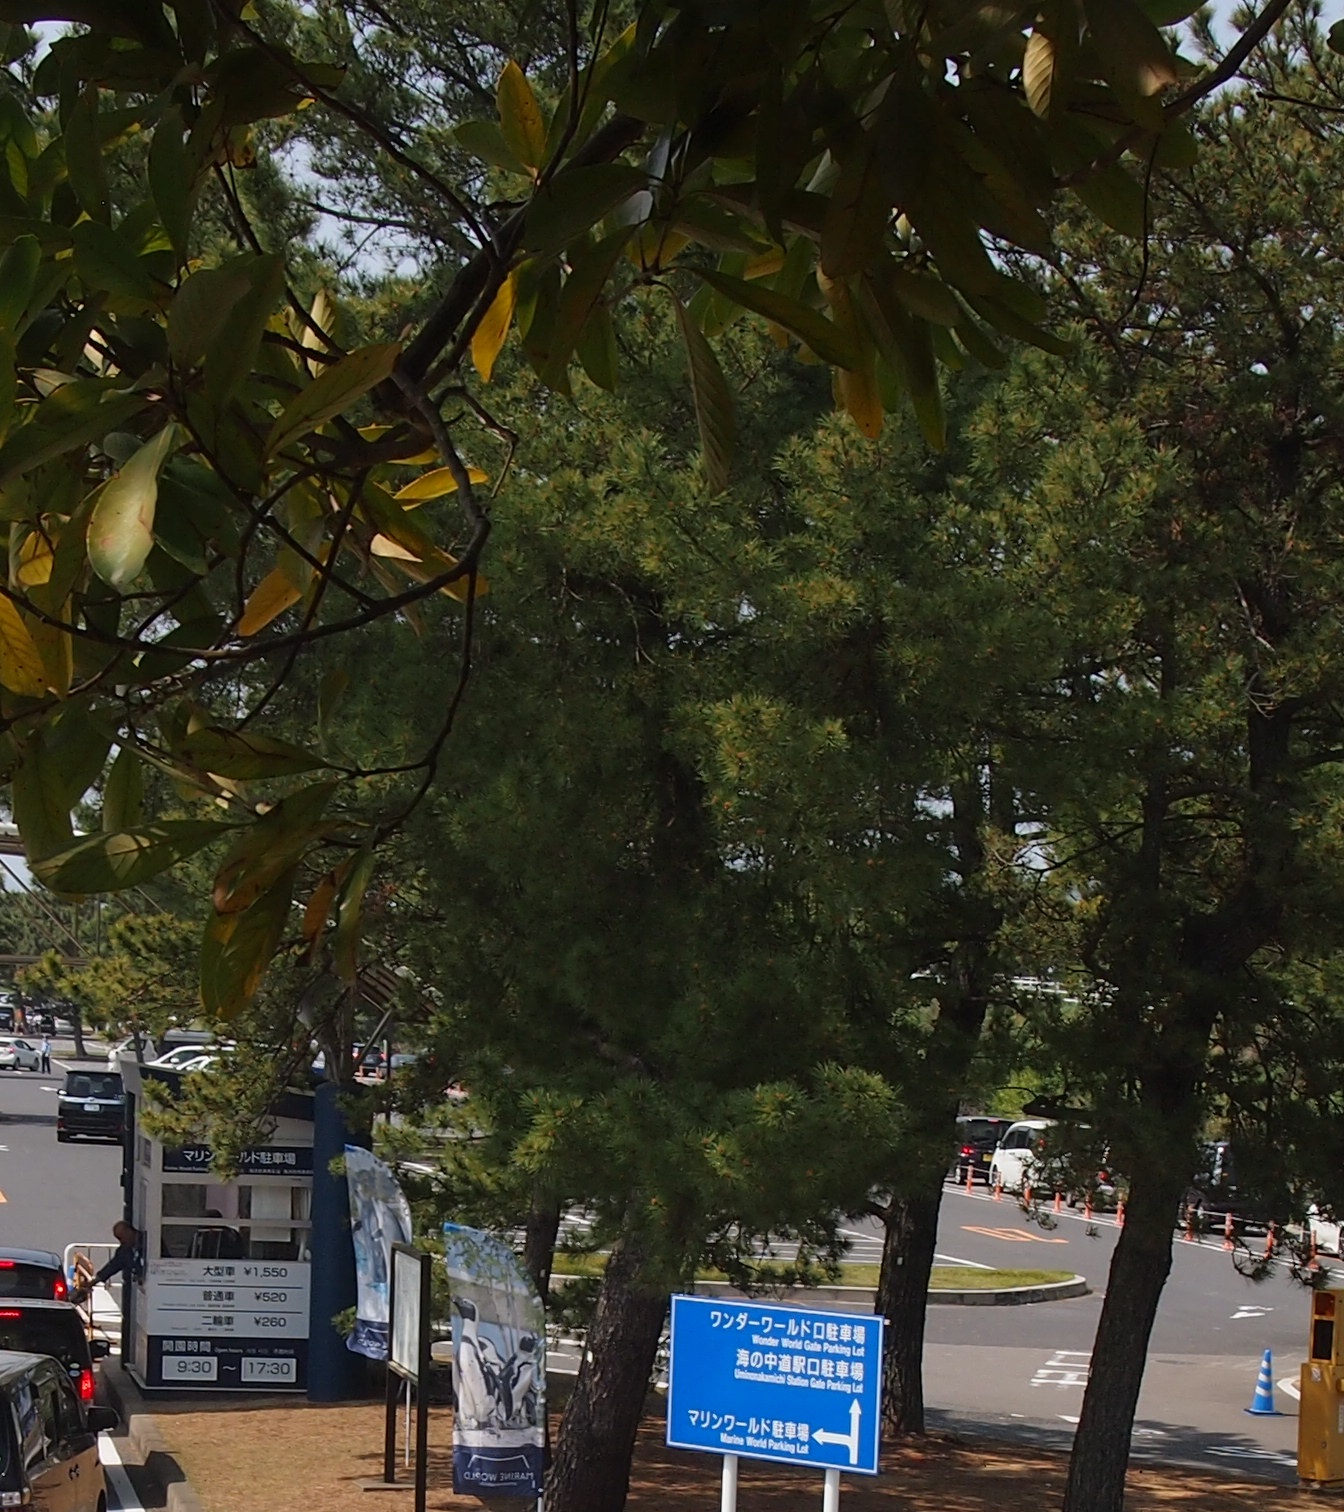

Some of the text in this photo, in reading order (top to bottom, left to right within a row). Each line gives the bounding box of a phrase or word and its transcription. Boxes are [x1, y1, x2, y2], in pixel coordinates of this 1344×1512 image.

[183, 1150, 296, 1166] マリンールド駐車場
[203, 1266, 235, 1277] 大型車
[255, 1292, 287, 1303] ¥520
[254, 1317, 287, 1328] ¥260
[710, 1311, 866, 1345] ワンダーワールド口駐車場
[752, 1334, 865, 1357] Wonder World Gate Parking Lot
[177, 1360, 212, 1374] 9:30
[249, 1362, 291, 1375] 17:30
[736, 1348, 864, 1382] 海の中道駅口駐車場
[810, 1377, 826, 1389] Gate
[827, 1379, 851, 1394] Parking
[852, 1383, 863, 1393] Lot
[688, 1409, 810, 1443] マリンワールド駐車場
[720, 1432, 809, 1455] Marine World Parking Lot
